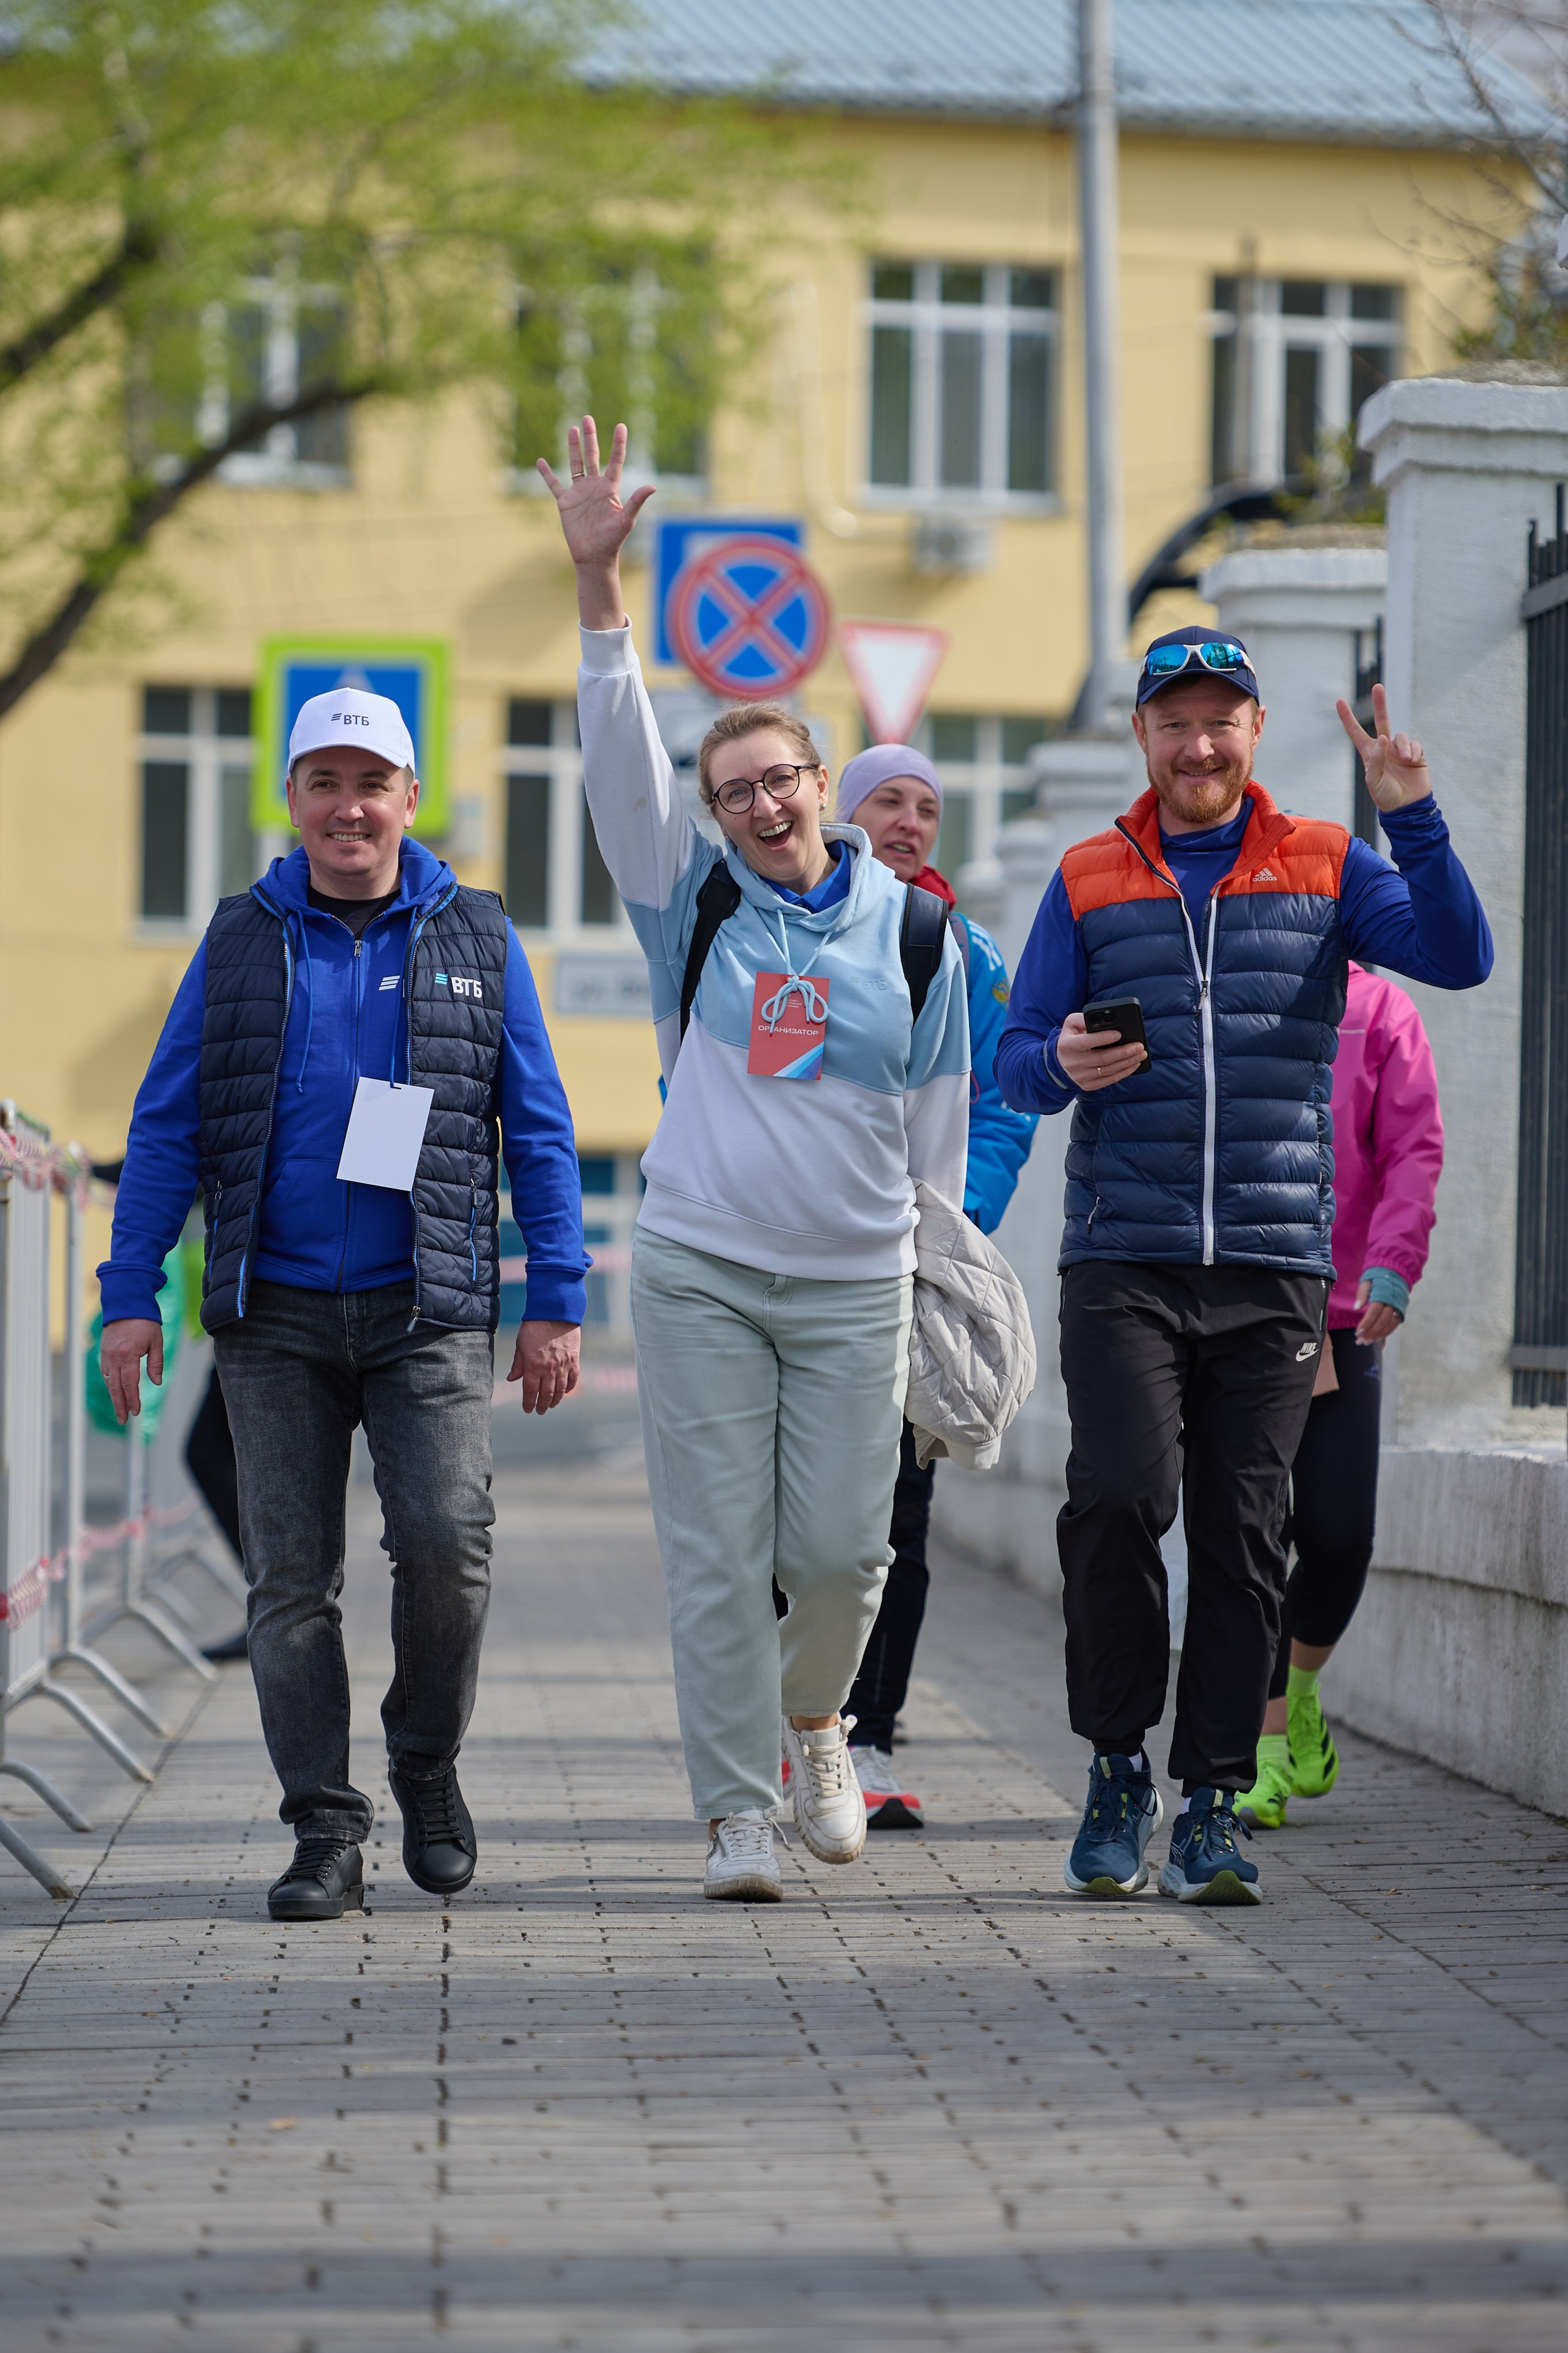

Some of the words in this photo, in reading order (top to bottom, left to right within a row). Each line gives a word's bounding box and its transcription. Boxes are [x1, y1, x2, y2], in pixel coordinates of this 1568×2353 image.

[344, 714, 369, 726] ВТБ
[451, 976, 483, 998] ВТБ
[861, 979, 887, 991] ВТБ
[758, 1025, 819, 1036] ОРАНИЗАТОР
[1300, 1342, 1317, 1353] NIKE
